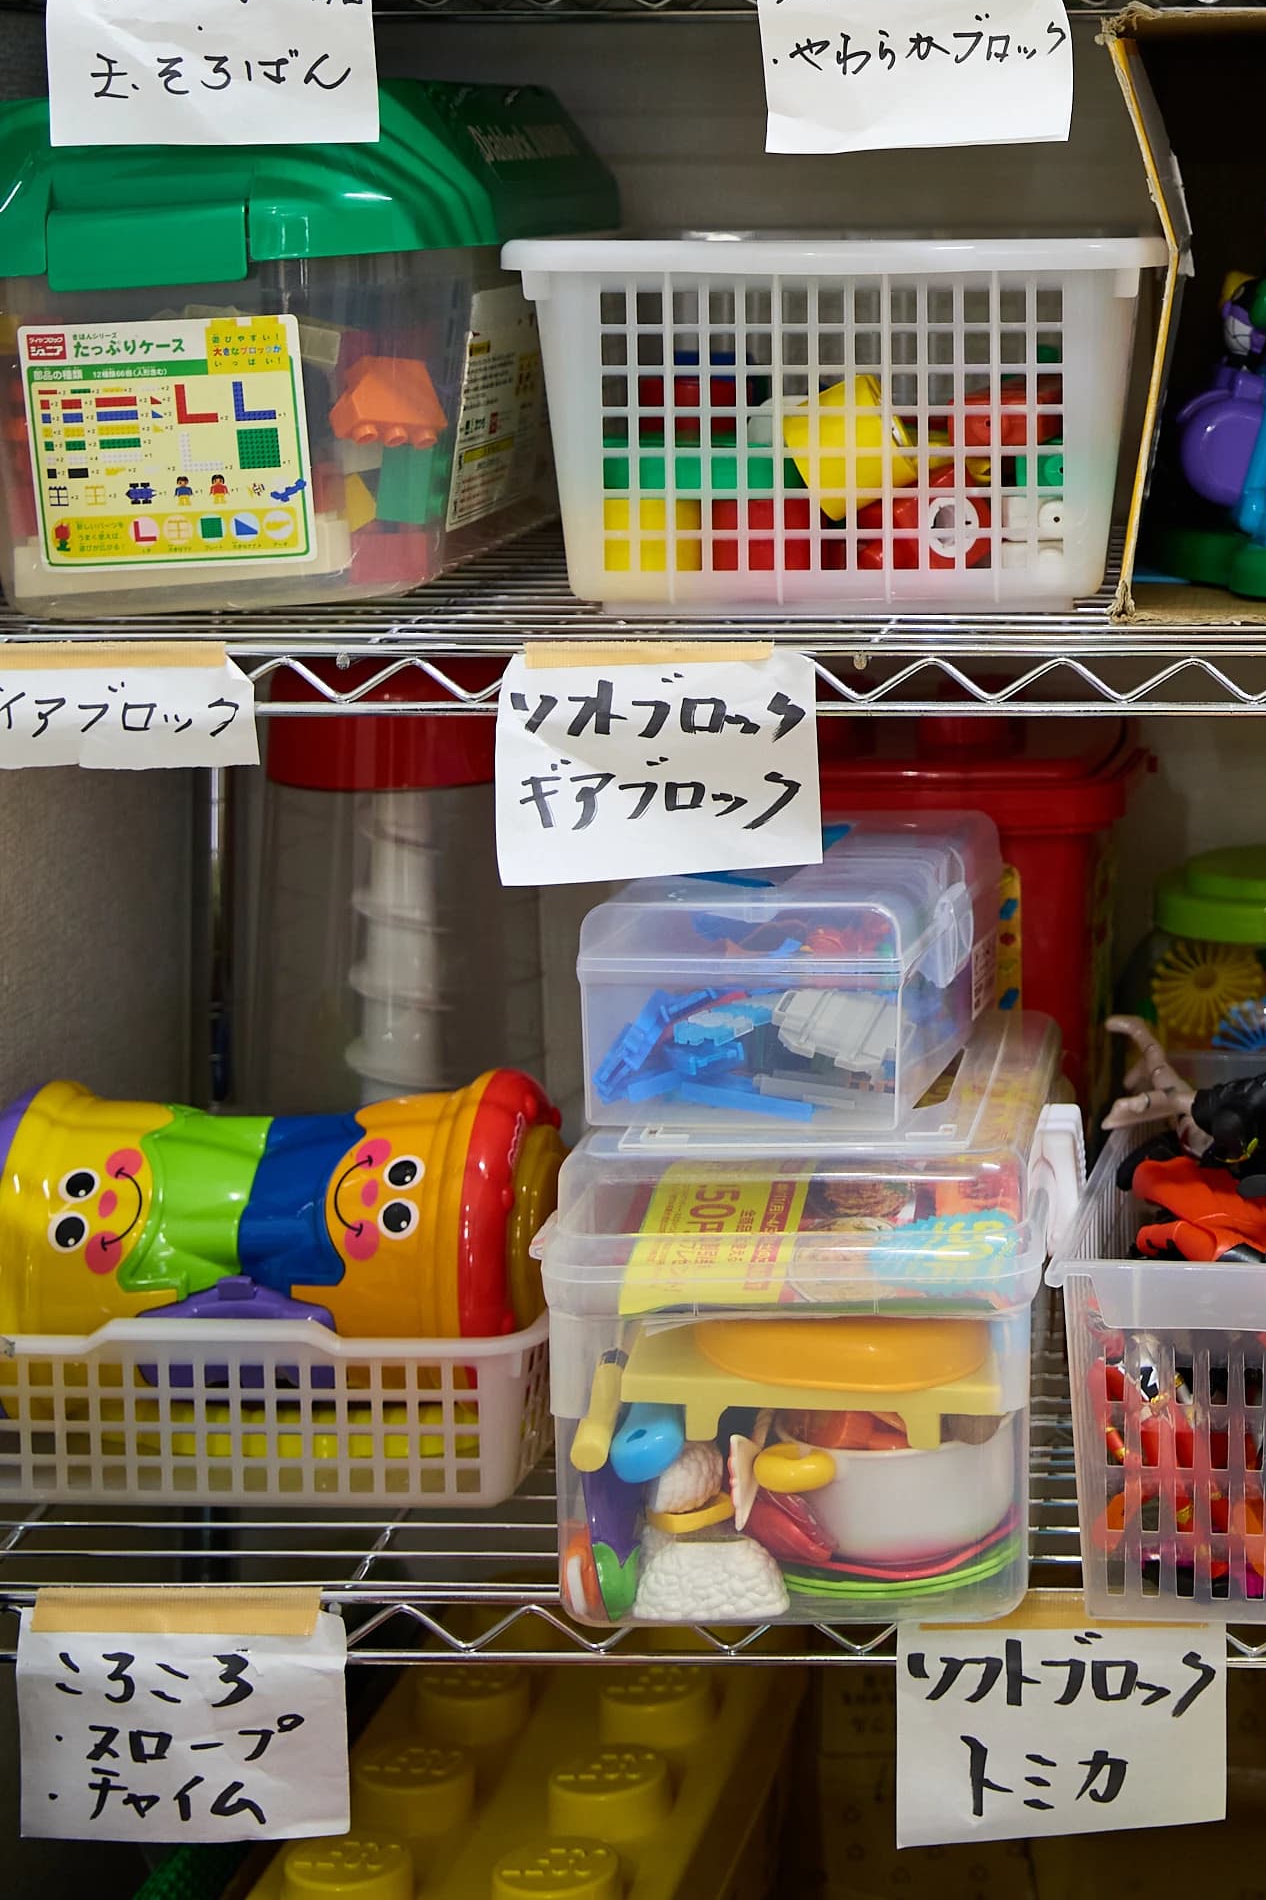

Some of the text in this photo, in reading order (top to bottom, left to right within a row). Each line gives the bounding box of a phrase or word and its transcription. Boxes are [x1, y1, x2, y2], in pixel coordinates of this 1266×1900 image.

[72, 332, 117, 341] きほんシリーズ
[30, 346, 64, 356] ジュニア
[73, 338, 185, 358] たっぷりケース
[213, 345, 281, 357] 大きなブロックが
[33, 369, 83, 381] 部品の種類
[519, 756, 805, 831] ギアブロック
[54, 1649, 255, 1708] ころころ
[960, 1733, 1129, 1818] トミカ
